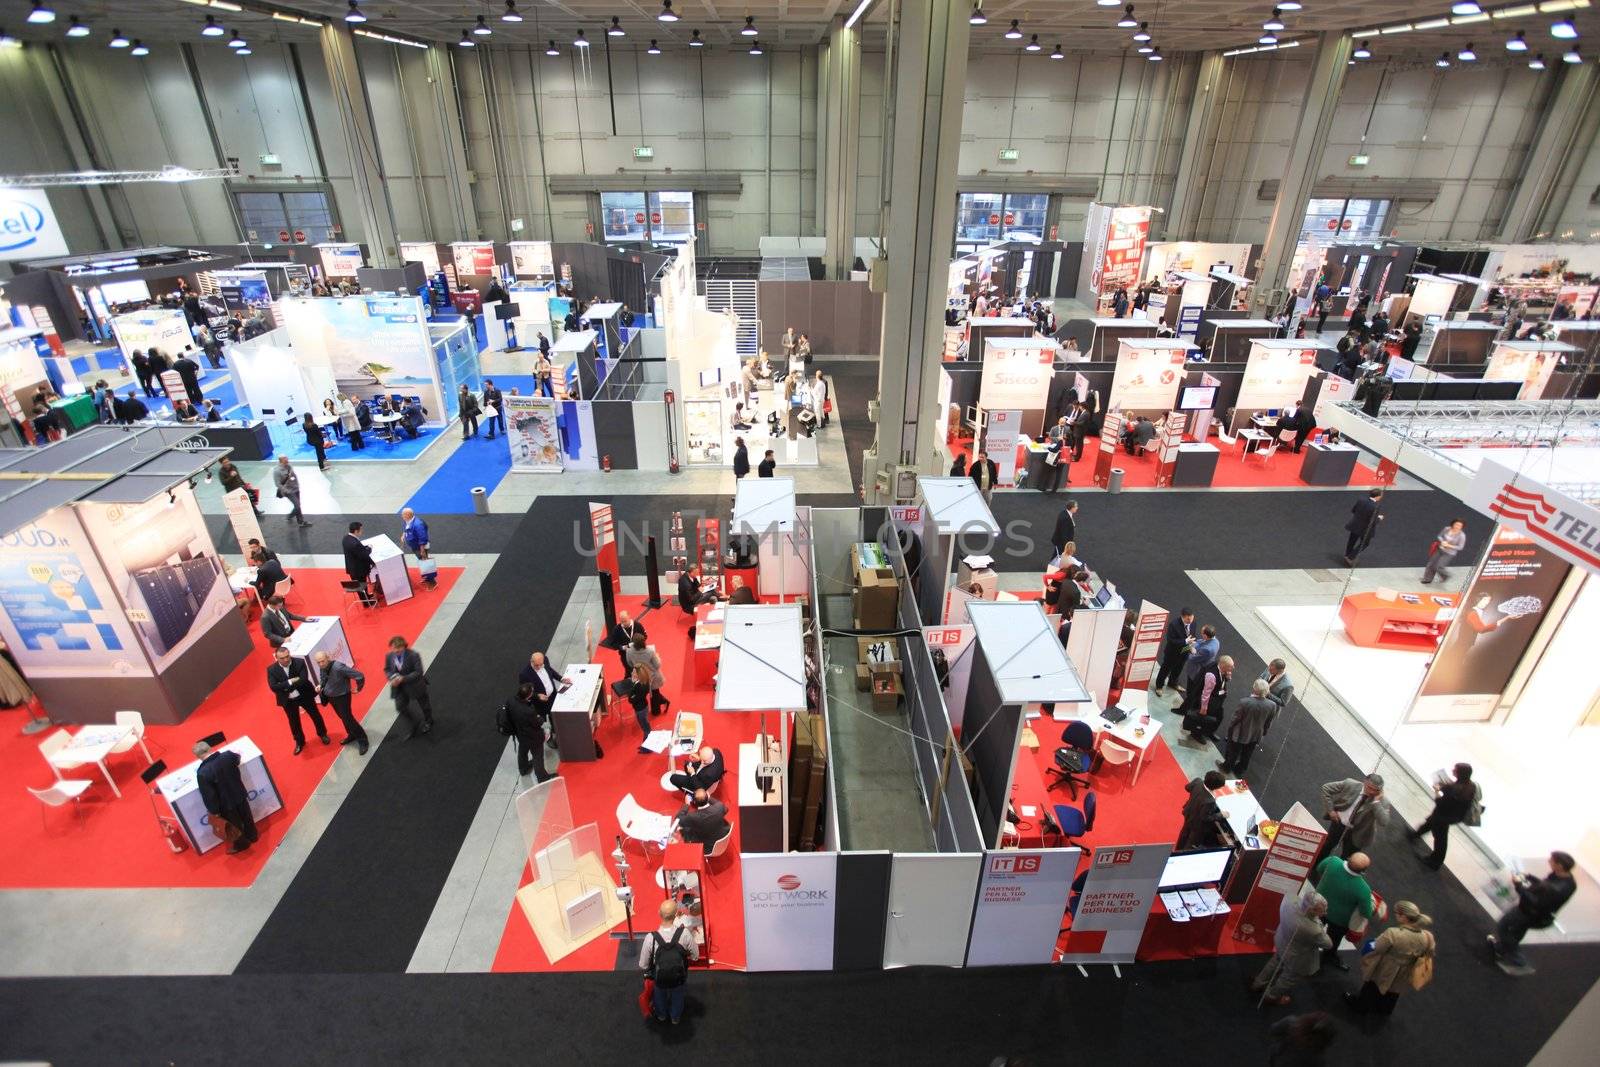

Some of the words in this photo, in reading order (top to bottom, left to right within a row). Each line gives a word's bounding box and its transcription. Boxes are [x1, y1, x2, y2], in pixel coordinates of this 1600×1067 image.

[894, 510, 905, 519] IT
[907, 510, 918, 519] IS
[930, 633, 941, 643] IT
[945, 631, 959, 641] IS
[1099, 853, 1113, 862] IT
[1116, 852, 1130, 861] IS
[995, 860, 1013, 870] IT
[1018, 858, 1037, 870] IS
[750, 891, 829, 901] SOFTWORK
[1085, 892, 1135, 900] PARTNER
[1120, 899, 1141, 907] TUO
[1081, 906, 1134, 914] BUSINESS
